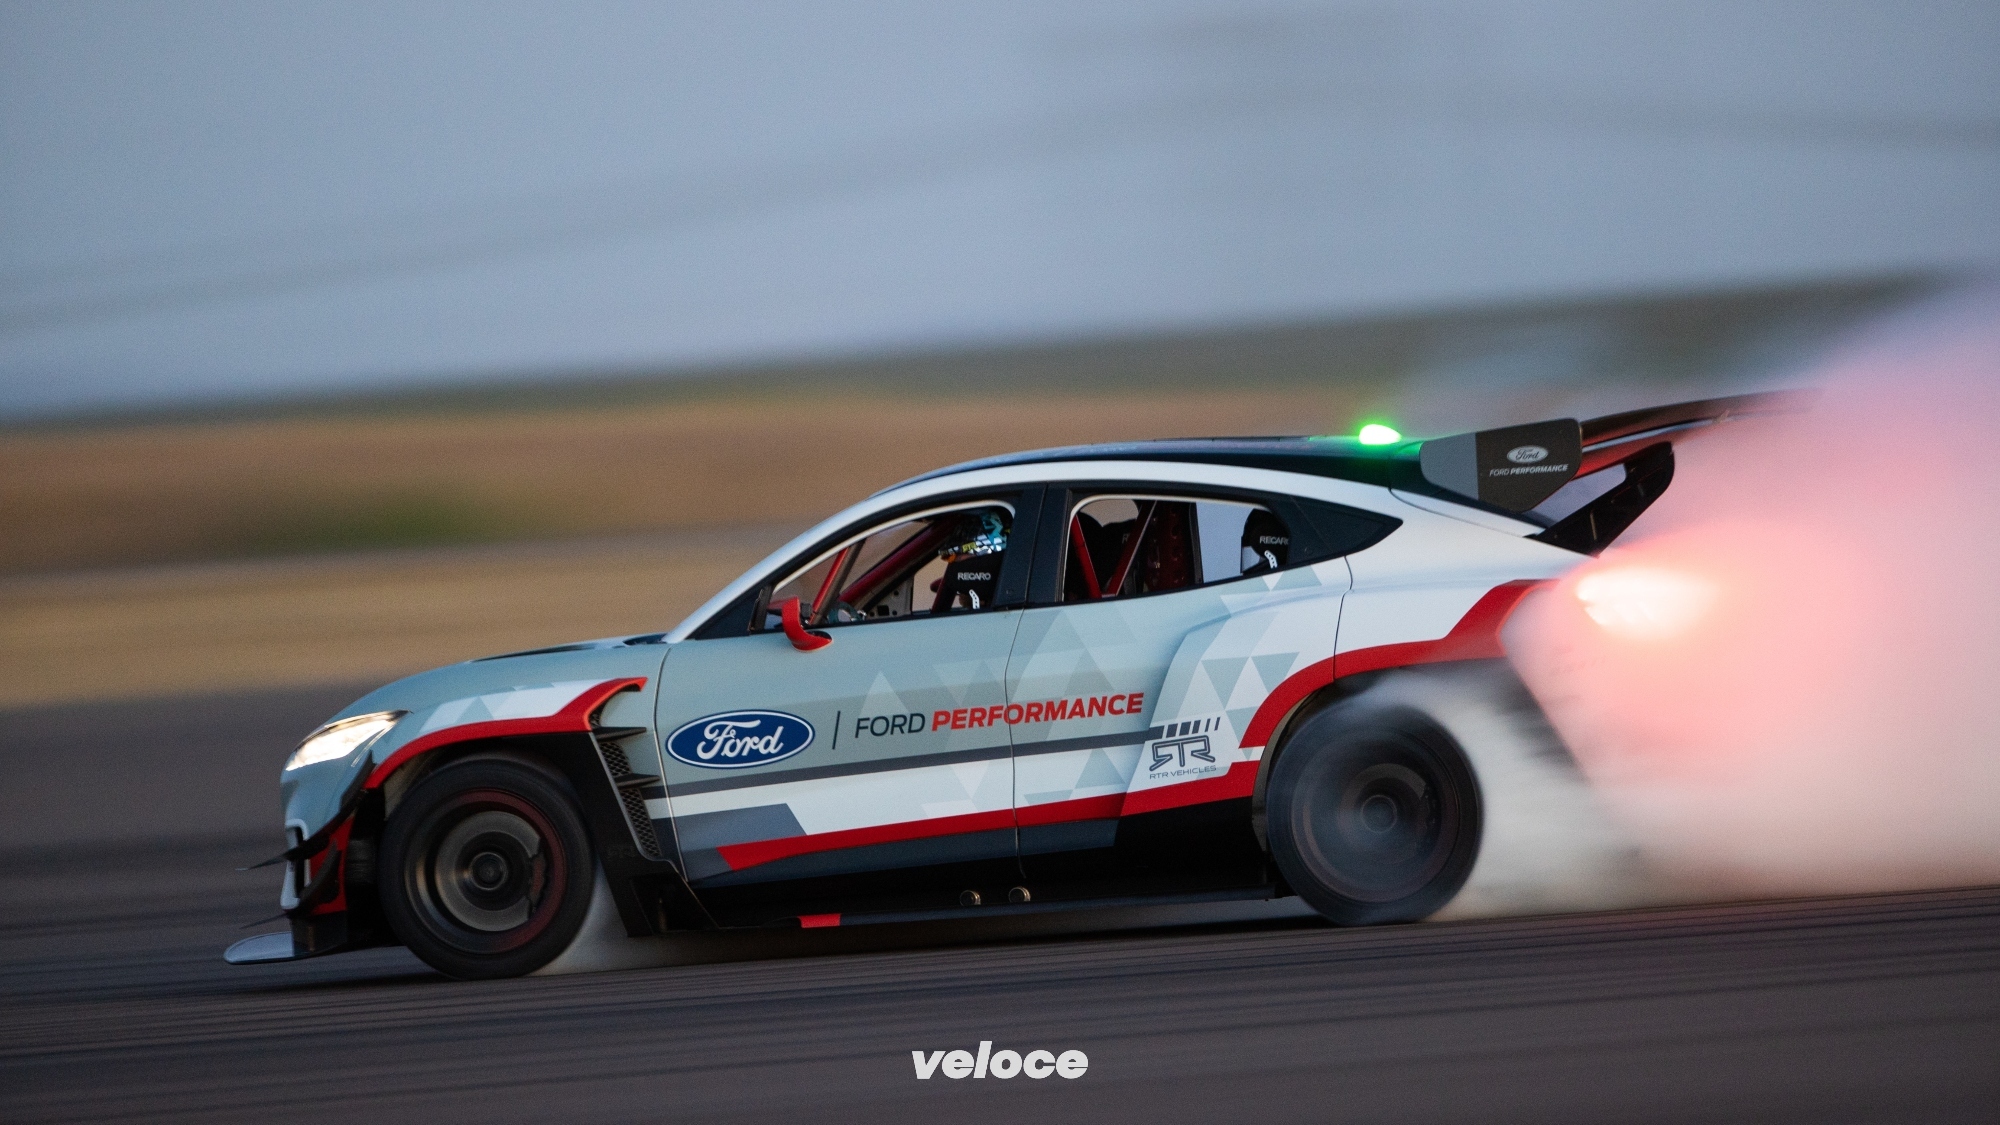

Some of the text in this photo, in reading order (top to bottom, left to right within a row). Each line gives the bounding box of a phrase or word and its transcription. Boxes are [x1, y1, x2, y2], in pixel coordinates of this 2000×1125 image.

[1515, 448, 1541, 460] Ford
[1489, 463, 1569, 477] FORD PERFORMANCE
[957, 571, 992, 581] RECARO
[854, 691, 1144, 738] FORD PERFORMANCE
[696, 719, 784, 760] Ford
[1149, 764, 1217, 780] RTR VEHICLES
